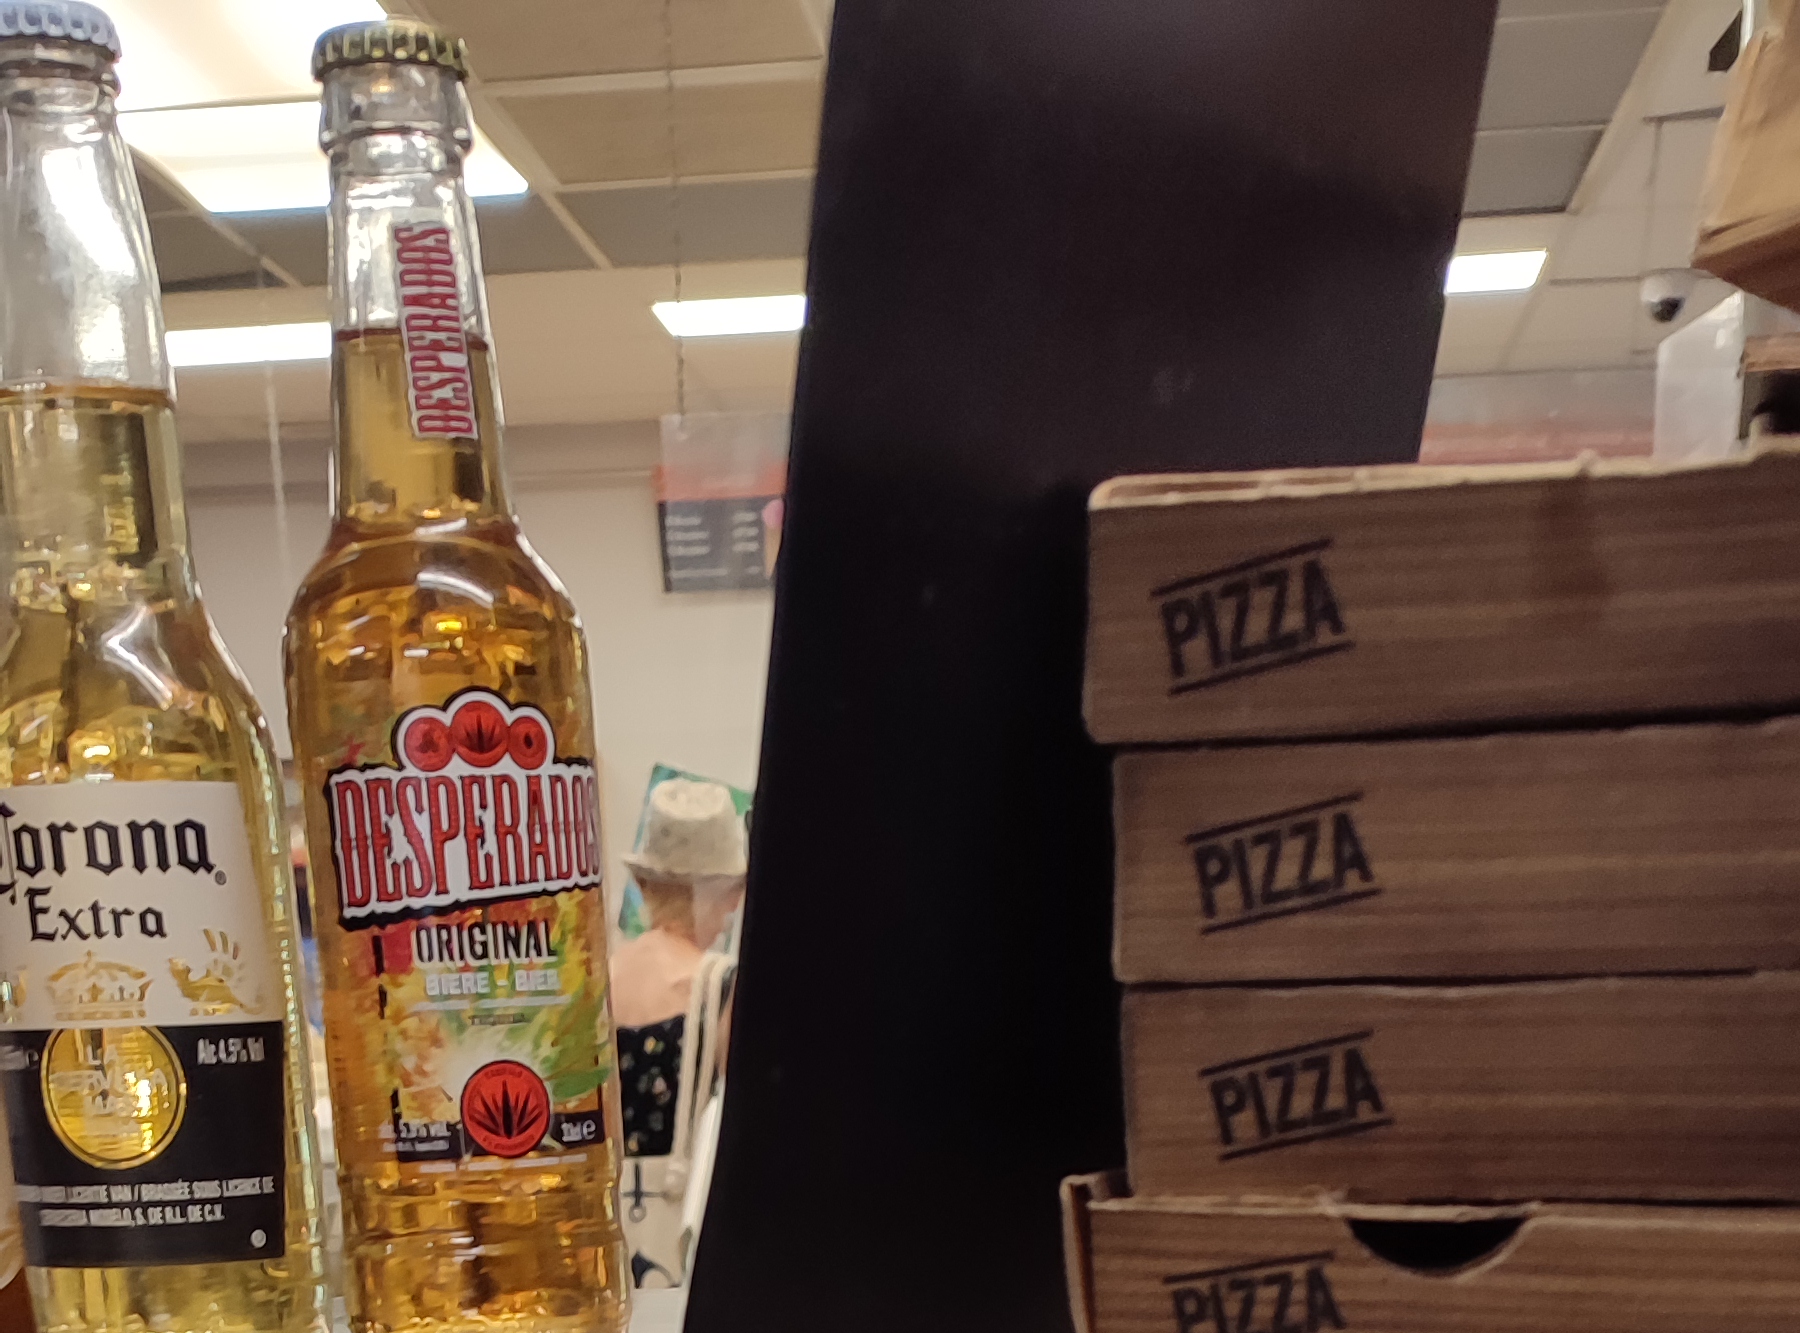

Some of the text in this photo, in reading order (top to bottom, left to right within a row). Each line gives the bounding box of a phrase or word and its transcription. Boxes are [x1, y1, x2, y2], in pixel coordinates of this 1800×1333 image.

[393, 227, 475, 434] DESPERADOS
[1160, 559, 1346, 678] PIZZA
[24, 887, 167, 942] Extra
[1193, 812, 1375, 920] PIZZA
[413, 919, 558, 966] ORIGINAL
[1210, 1047, 1384, 1145] PIZZA
